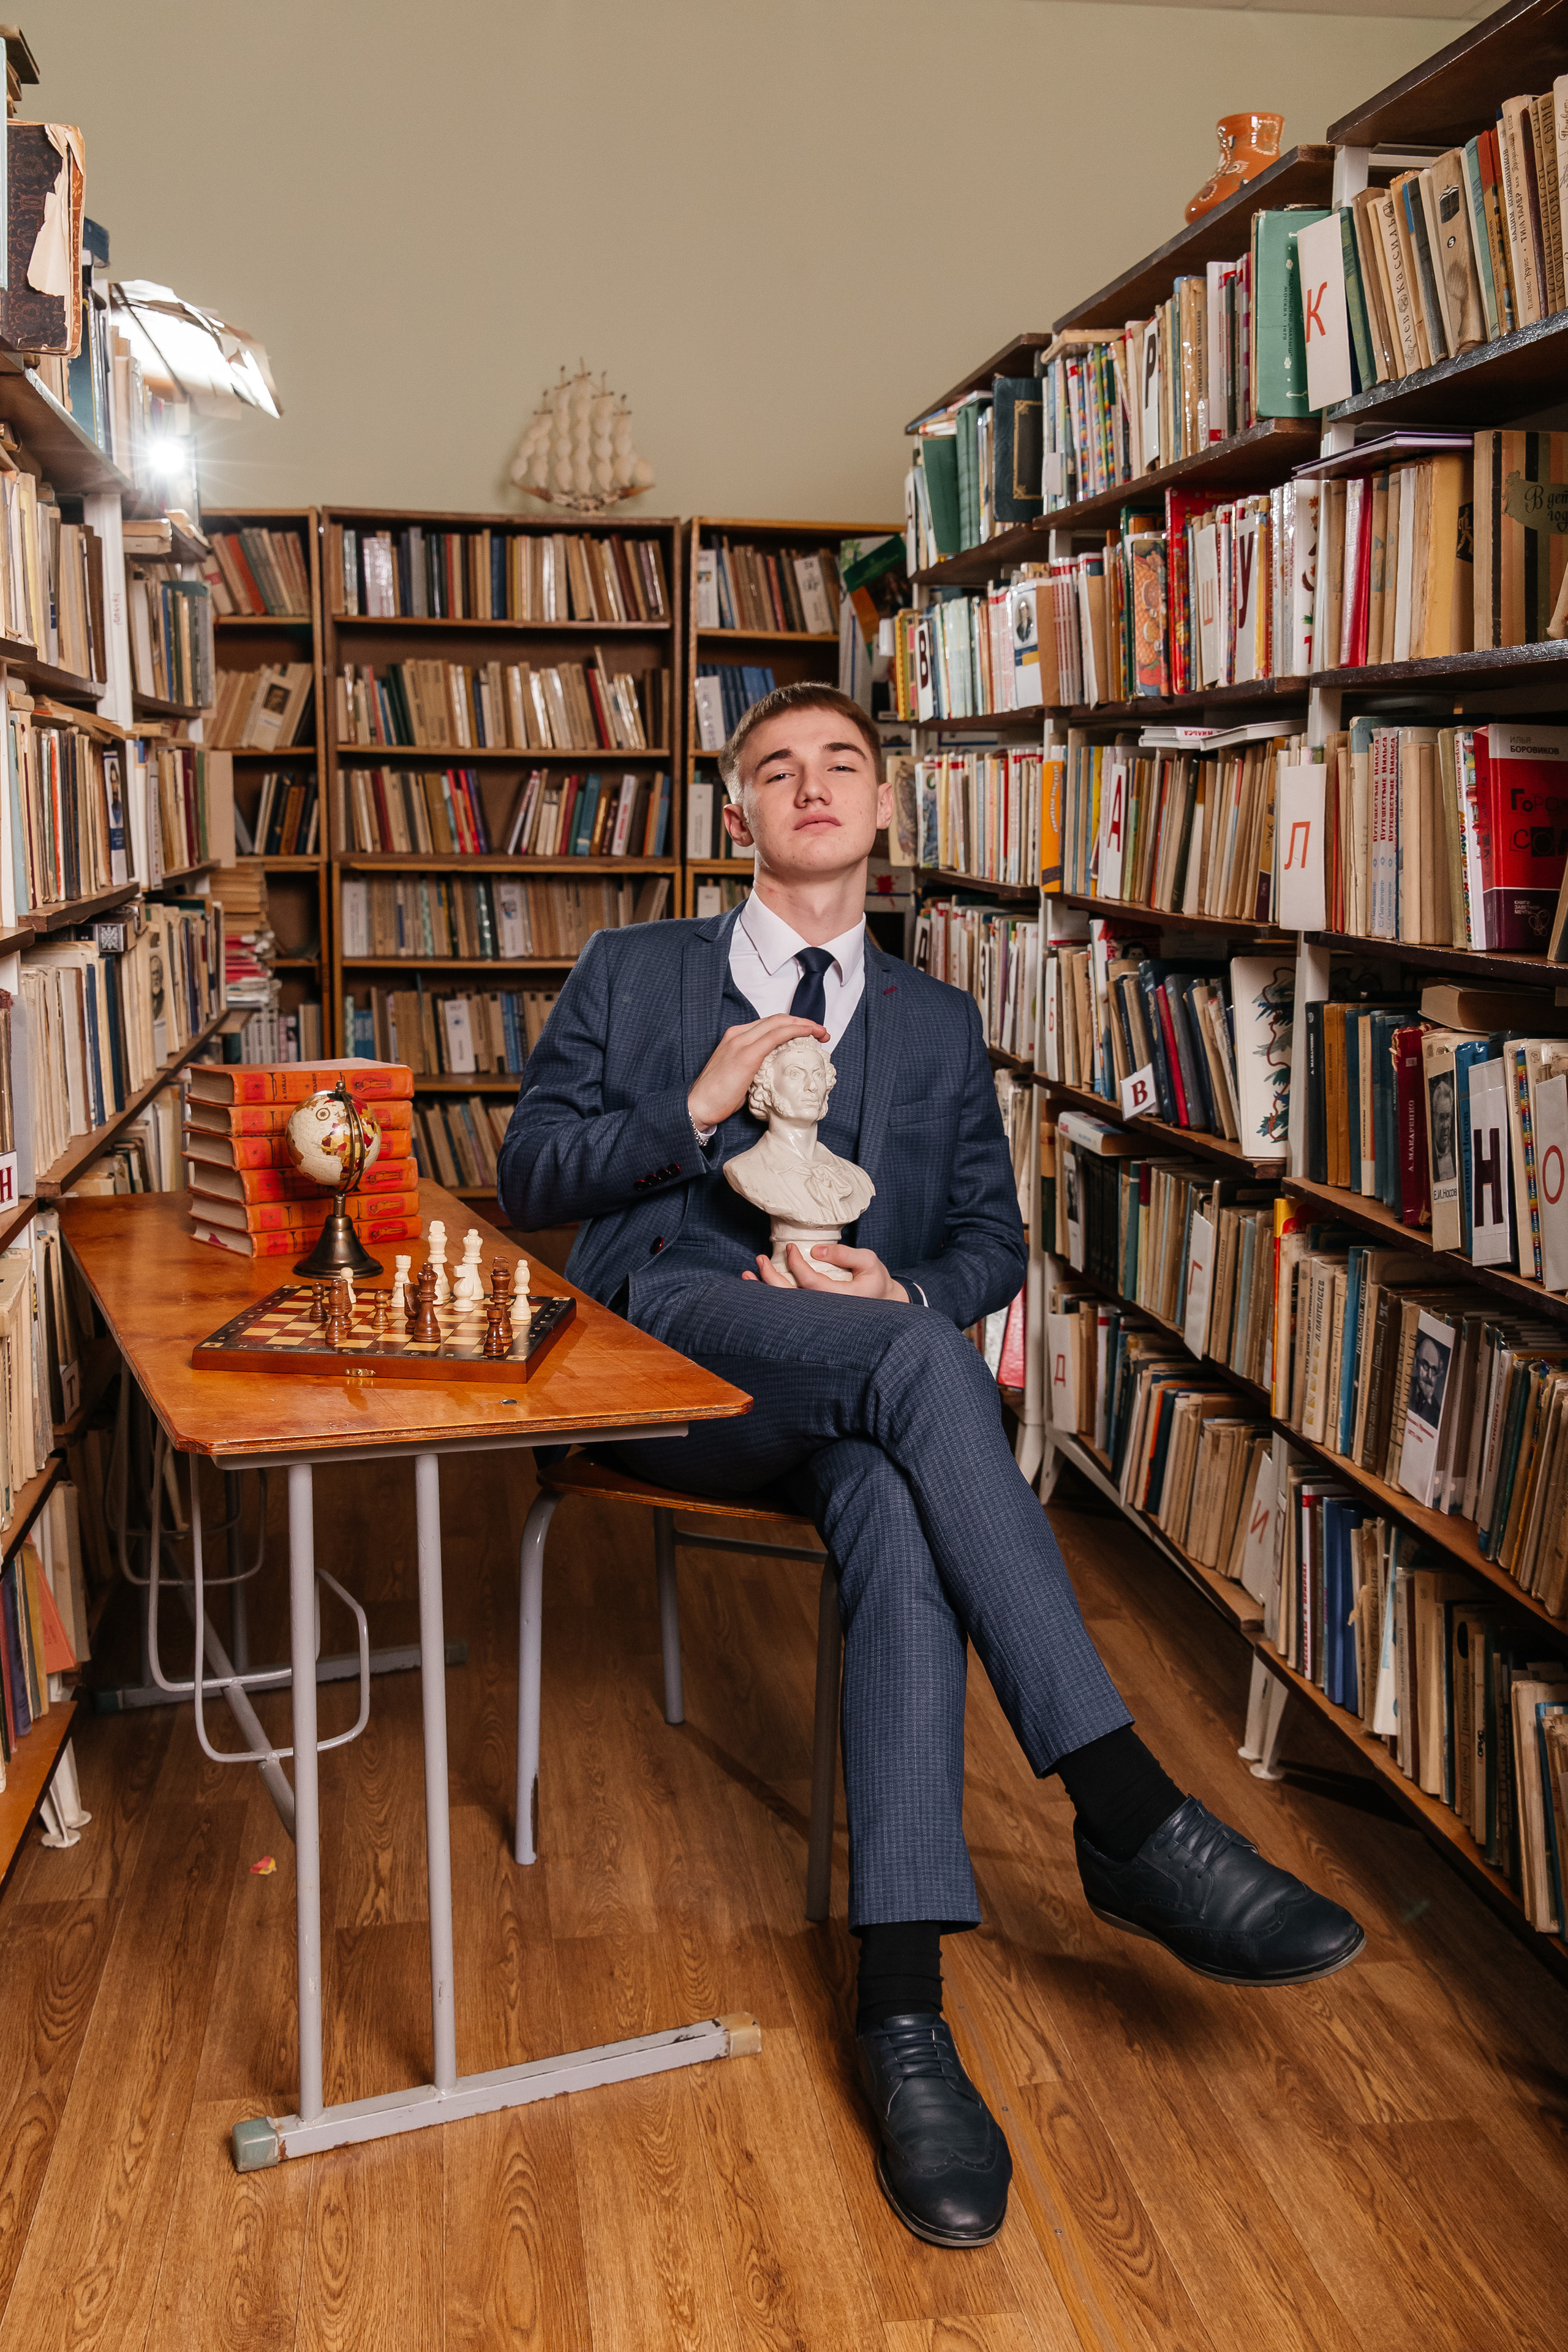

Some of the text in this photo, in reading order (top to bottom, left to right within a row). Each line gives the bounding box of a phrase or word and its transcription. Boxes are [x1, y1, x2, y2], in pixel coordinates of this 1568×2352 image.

[1541, 102, 1554, 144] СЫНЕ
[1502, 148, 1513, 208] КОЖЕВНИКОВ
[1547, 159, 1561, 224] ПОВЕСТЬ
[1515, 192, 1525, 219] ТАЛЕР
[1448, 236, 1455, 247] 5
[1551, 234, 1565, 293] КОШЕВАЯ
[1523, 257, 1532, 280] Крюс
[1305, 281, 1327, 343] К
[1145, 333, 1156, 410] Р
[1525, 486, 1544, 513] В
[1238, 530, 1254, 629] У
[1510, 745, 1559, 756] БОРОВИКОВ
[1107, 775, 1121, 852] А
[1284, 821, 1311, 870] Л
[1458, 811, 1469, 868] МАЛЫШ
[1131, 1080, 1147, 1107] В
[1408, 1163, 1415, 1172] А.
[1474, 1128, 1504, 1227] Н
[1527, 1145, 1536, 1199] Приключения
[1542, 1145, 1564, 1204] О
[1188, 1260, 1202, 1295] Г
[1315, 1280, 1324, 1332] ПАНТЕЛЕЕВ
[1054, 1354, 1066, 1387] Д
[1251, 1499, 1270, 1545] И
